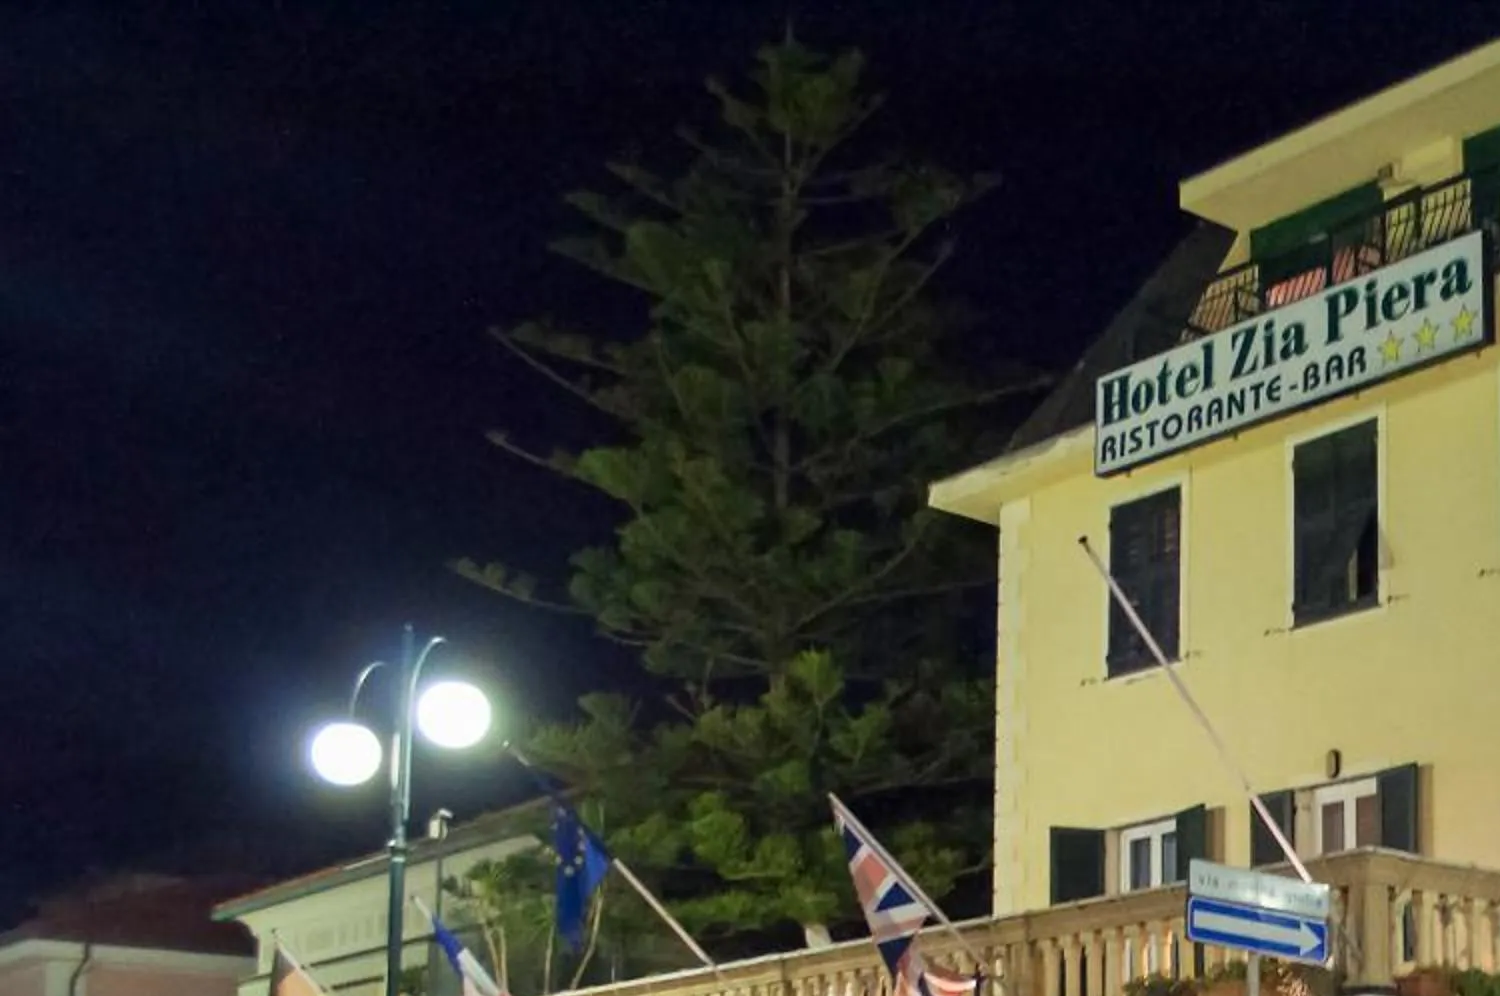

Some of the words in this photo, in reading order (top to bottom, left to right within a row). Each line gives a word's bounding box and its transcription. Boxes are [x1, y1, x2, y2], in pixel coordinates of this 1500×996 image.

[1101, 342, 1214, 428] Hotel
[1230, 318, 1310, 379] Zia
[1324, 255, 1473, 345] Piera
